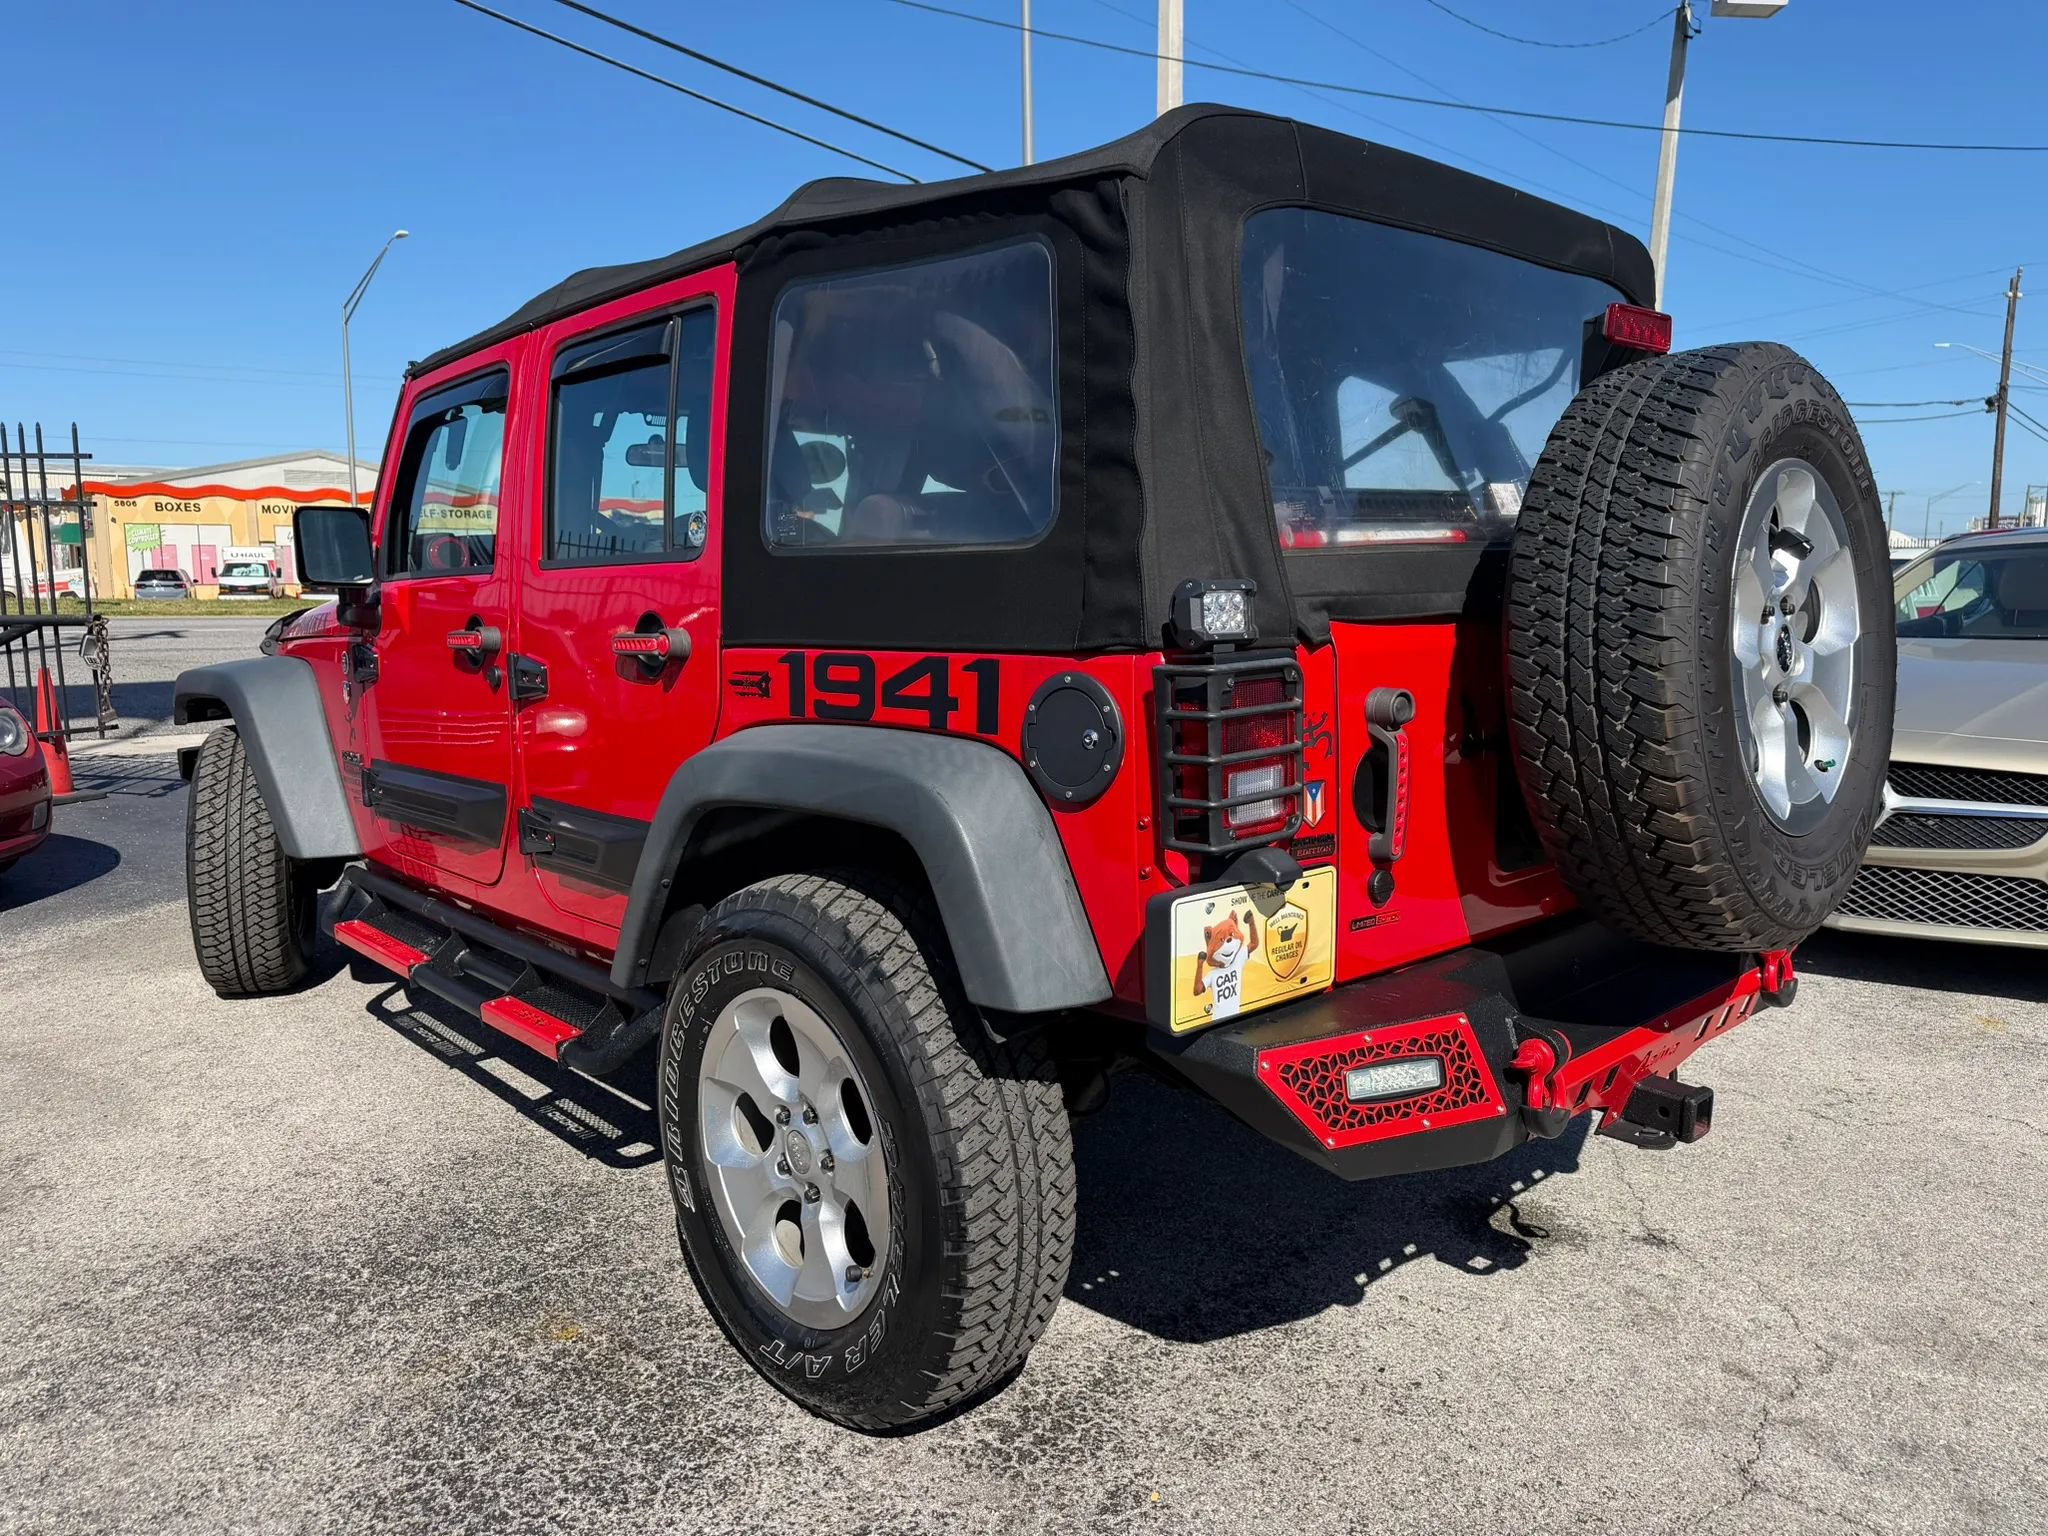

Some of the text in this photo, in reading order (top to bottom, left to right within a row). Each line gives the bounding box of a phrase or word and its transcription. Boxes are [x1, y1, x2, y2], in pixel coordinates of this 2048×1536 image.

[154, 502, 201, 512] BOXES
[777, 650, 1000, 736] 1941
[1271, 943, 1295, 955] REGULAR
[1275, 950, 1299, 962] CHANGES
[1216, 970, 1238, 988] CAR
[1217, 984, 1237, 1003] FOX
[665, 950, 796, 1213] BRIDGESTONE
[759, 1340, 832, 1378] A/T
